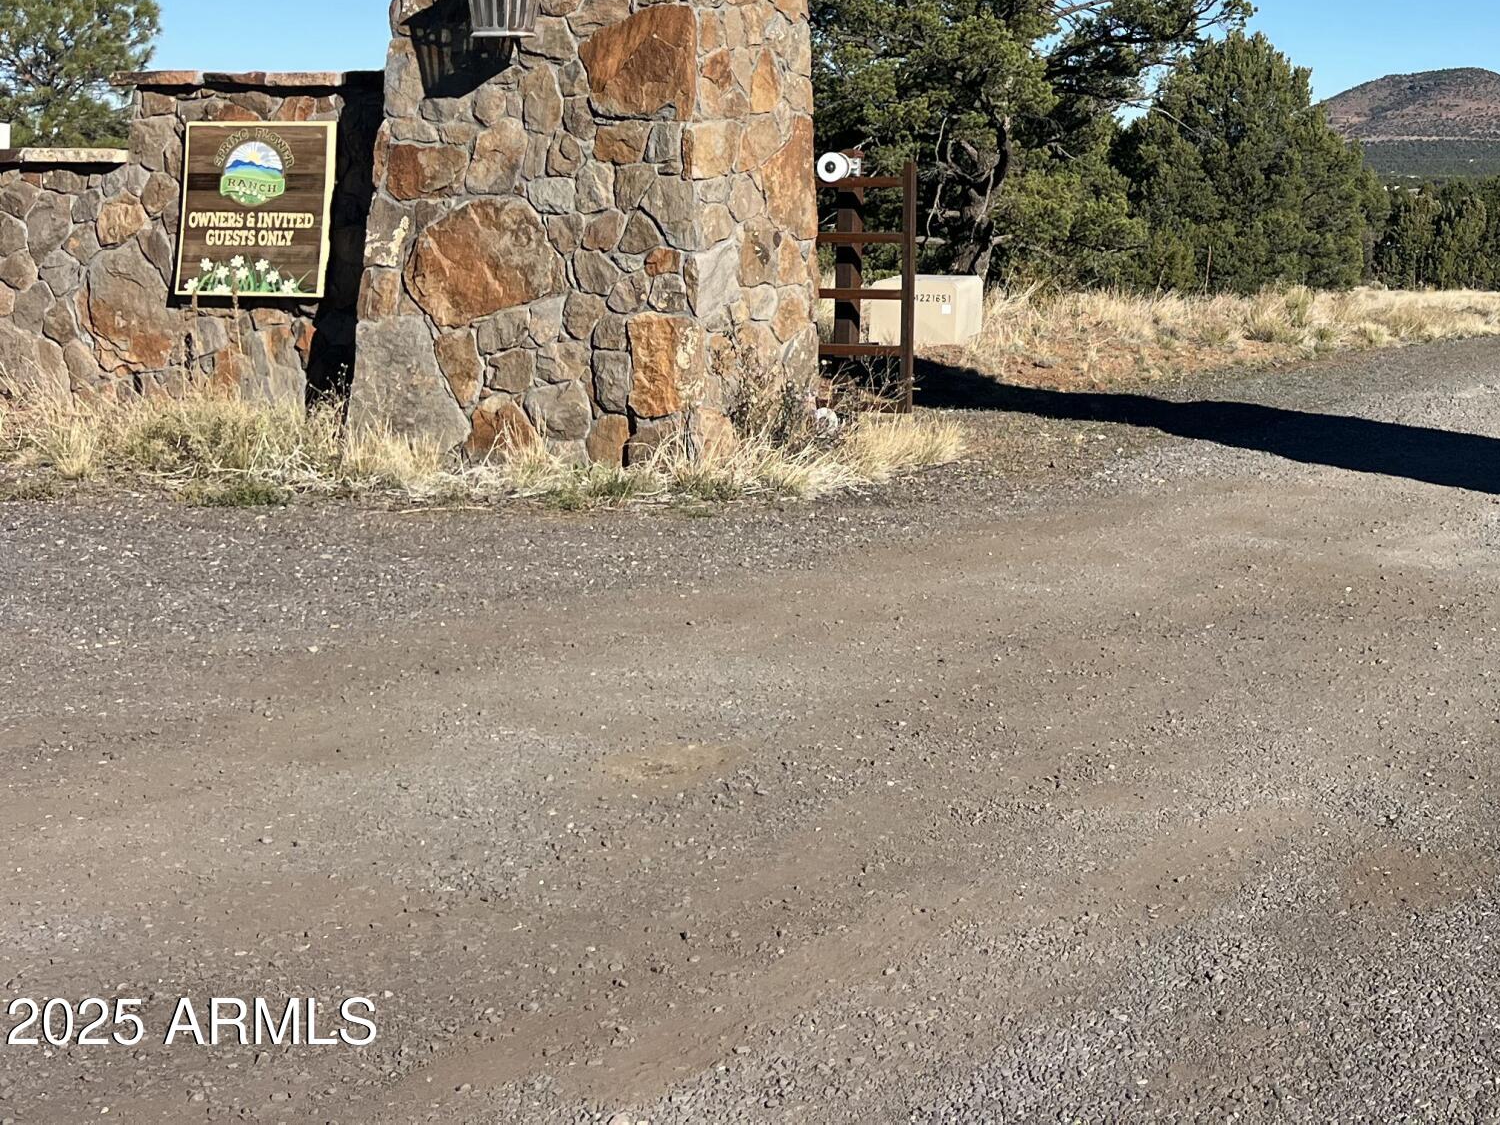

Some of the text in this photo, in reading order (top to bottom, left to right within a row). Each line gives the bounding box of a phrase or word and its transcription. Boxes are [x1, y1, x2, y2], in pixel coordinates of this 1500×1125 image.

[214, 127, 294, 168] SPRING FLOWER
[227, 178, 277, 192] RANCH
[188, 212, 315, 229] OWNERS & INVITED
[206, 230, 294, 246] GUESTS ONLY
